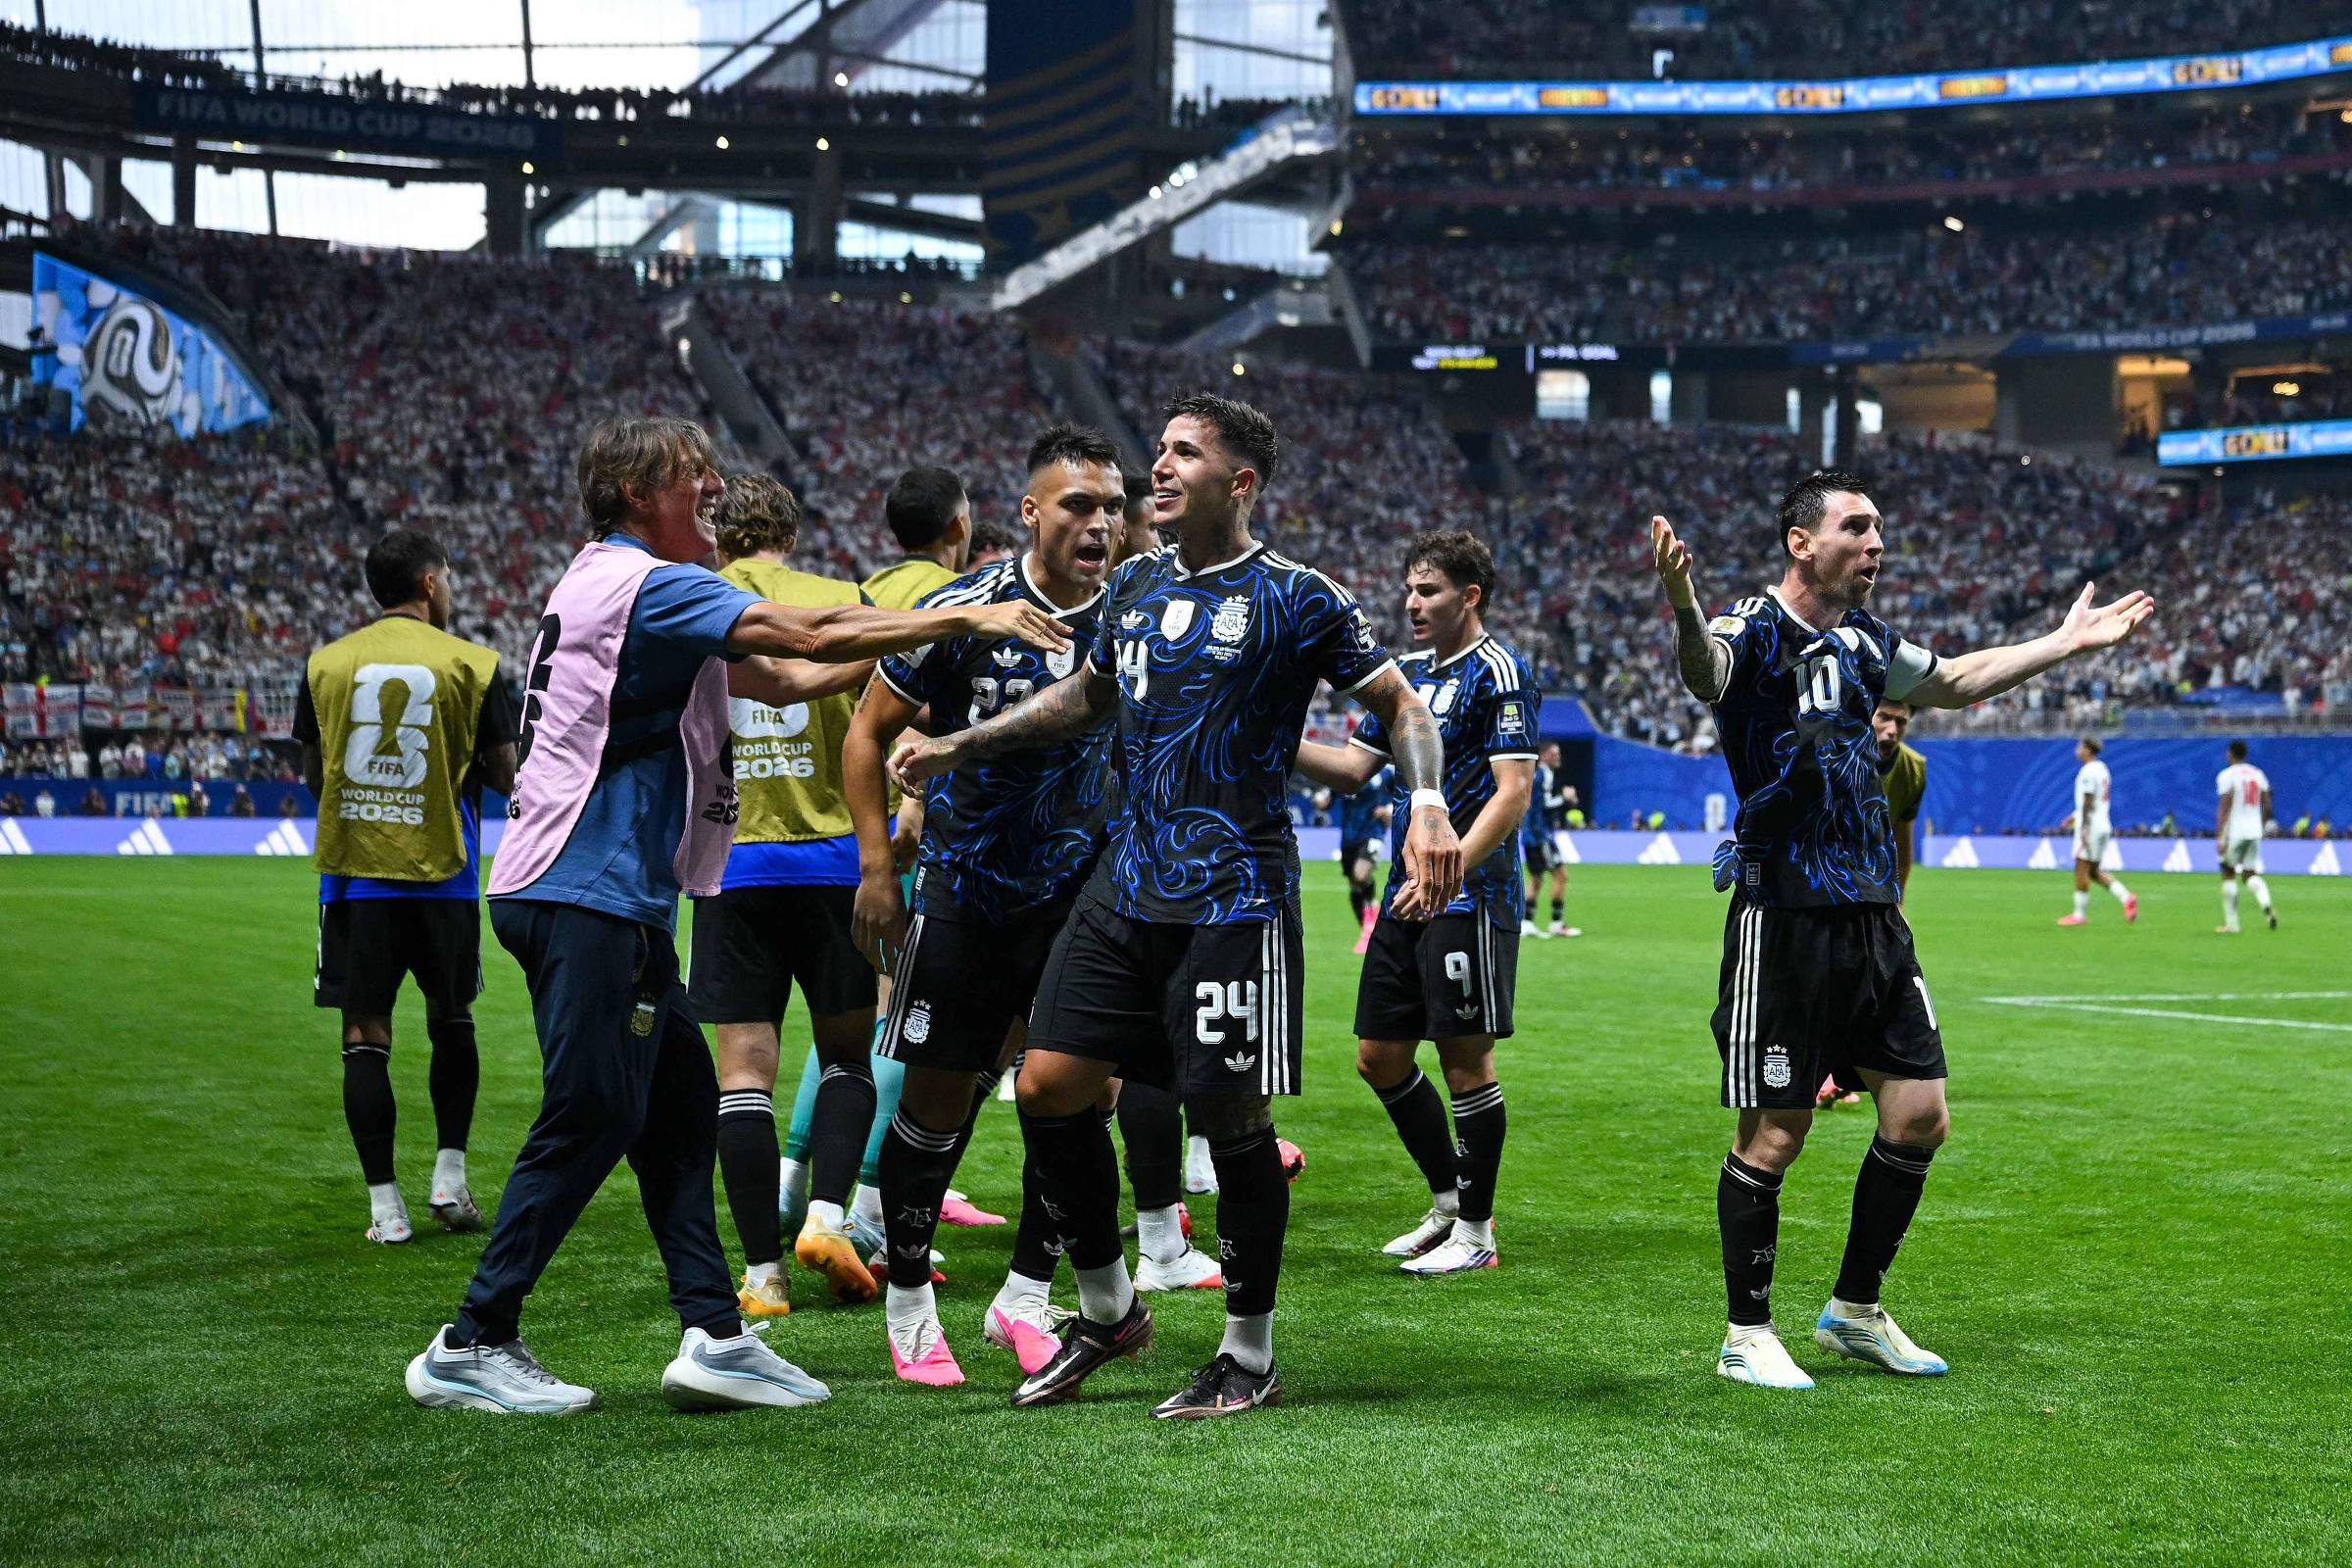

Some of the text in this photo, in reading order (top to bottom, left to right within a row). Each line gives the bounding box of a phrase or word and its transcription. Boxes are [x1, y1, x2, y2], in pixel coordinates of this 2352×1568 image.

[157, 93, 226, 122] FIFA
[234, 100, 351, 135] WORLD
[357, 110, 420, 137] CUP
[1793, 654, 1841, 714] 10
[752, 710, 785, 725] FIFA
[732, 741, 812, 757] WORLD CUP
[368, 760, 405, 776] FIFA
[732, 756, 815, 780] 2026
[341, 788, 425, 806] WORLD CUP
[338, 801, 424, 825] 2026
[1445, 951, 1472, 999] 9
[1196, 980, 1258, 1045] 24
